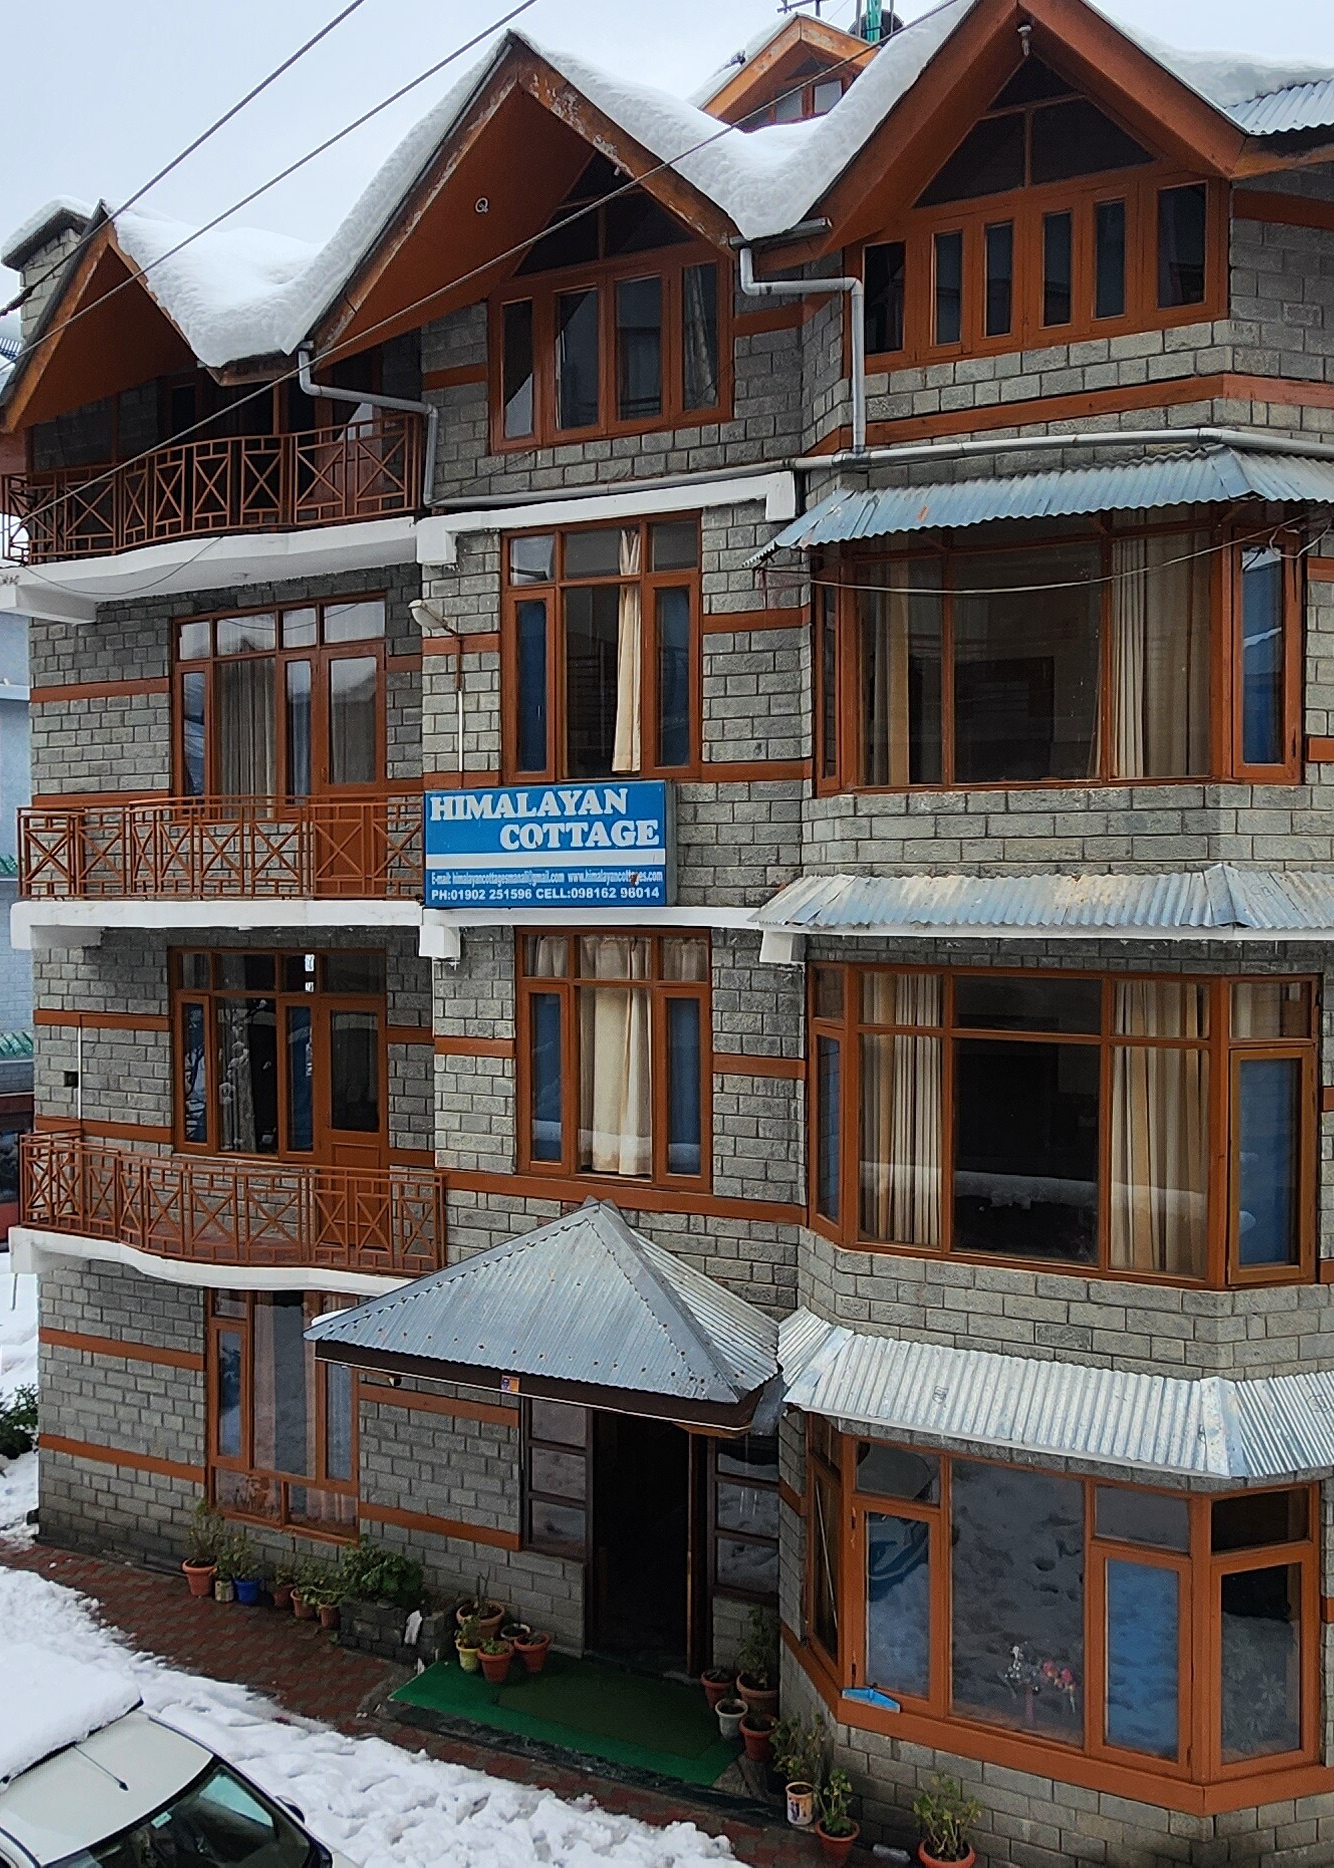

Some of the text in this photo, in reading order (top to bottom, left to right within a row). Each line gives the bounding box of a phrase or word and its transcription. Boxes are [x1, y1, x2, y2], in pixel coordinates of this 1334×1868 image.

[430, 788, 628, 821] HIMALAYAN
[500, 819, 660, 849] COTTAGE
[567, 868, 663, 887] www.himalayancottges.com
[431, 889, 486, 901] PH:01902
[488, 888, 533, 900] 251596
[535, 887, 617, 900] CELL:098162
